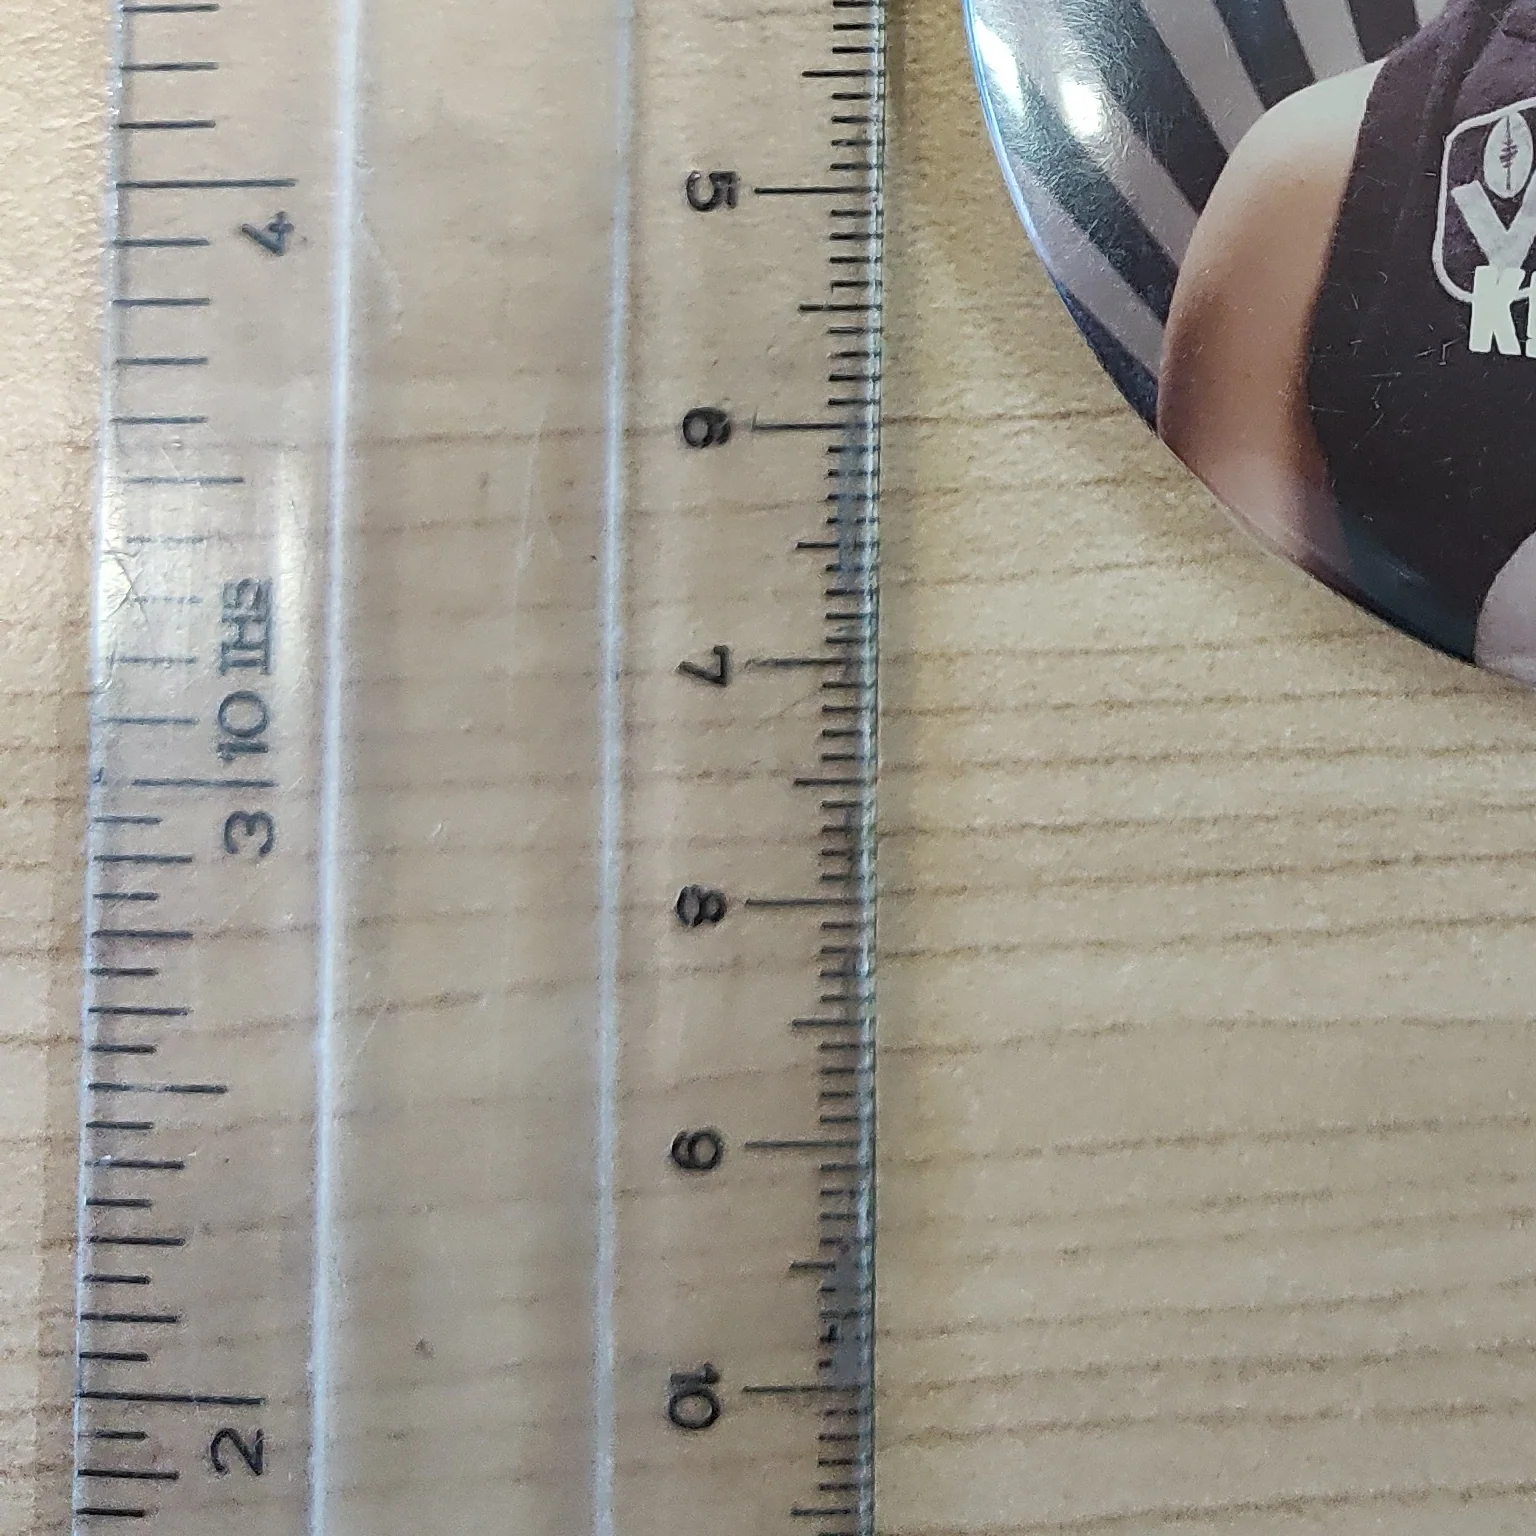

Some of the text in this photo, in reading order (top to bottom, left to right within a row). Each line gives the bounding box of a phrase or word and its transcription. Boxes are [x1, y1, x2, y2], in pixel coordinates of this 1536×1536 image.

[685, 171, 738, 212] 5
[242, 211, 295, 255] 4
[680, 407, 732, 449] 6
[676, 644, 729, 686] 7
[222, 807, 276, 858] 3
[674, 885, 727, 928] 8
[670, 1128, 723, 1170] 9
[667, 1362, 721, 1430] 10
[210, 1426, 266, 1477] 2
